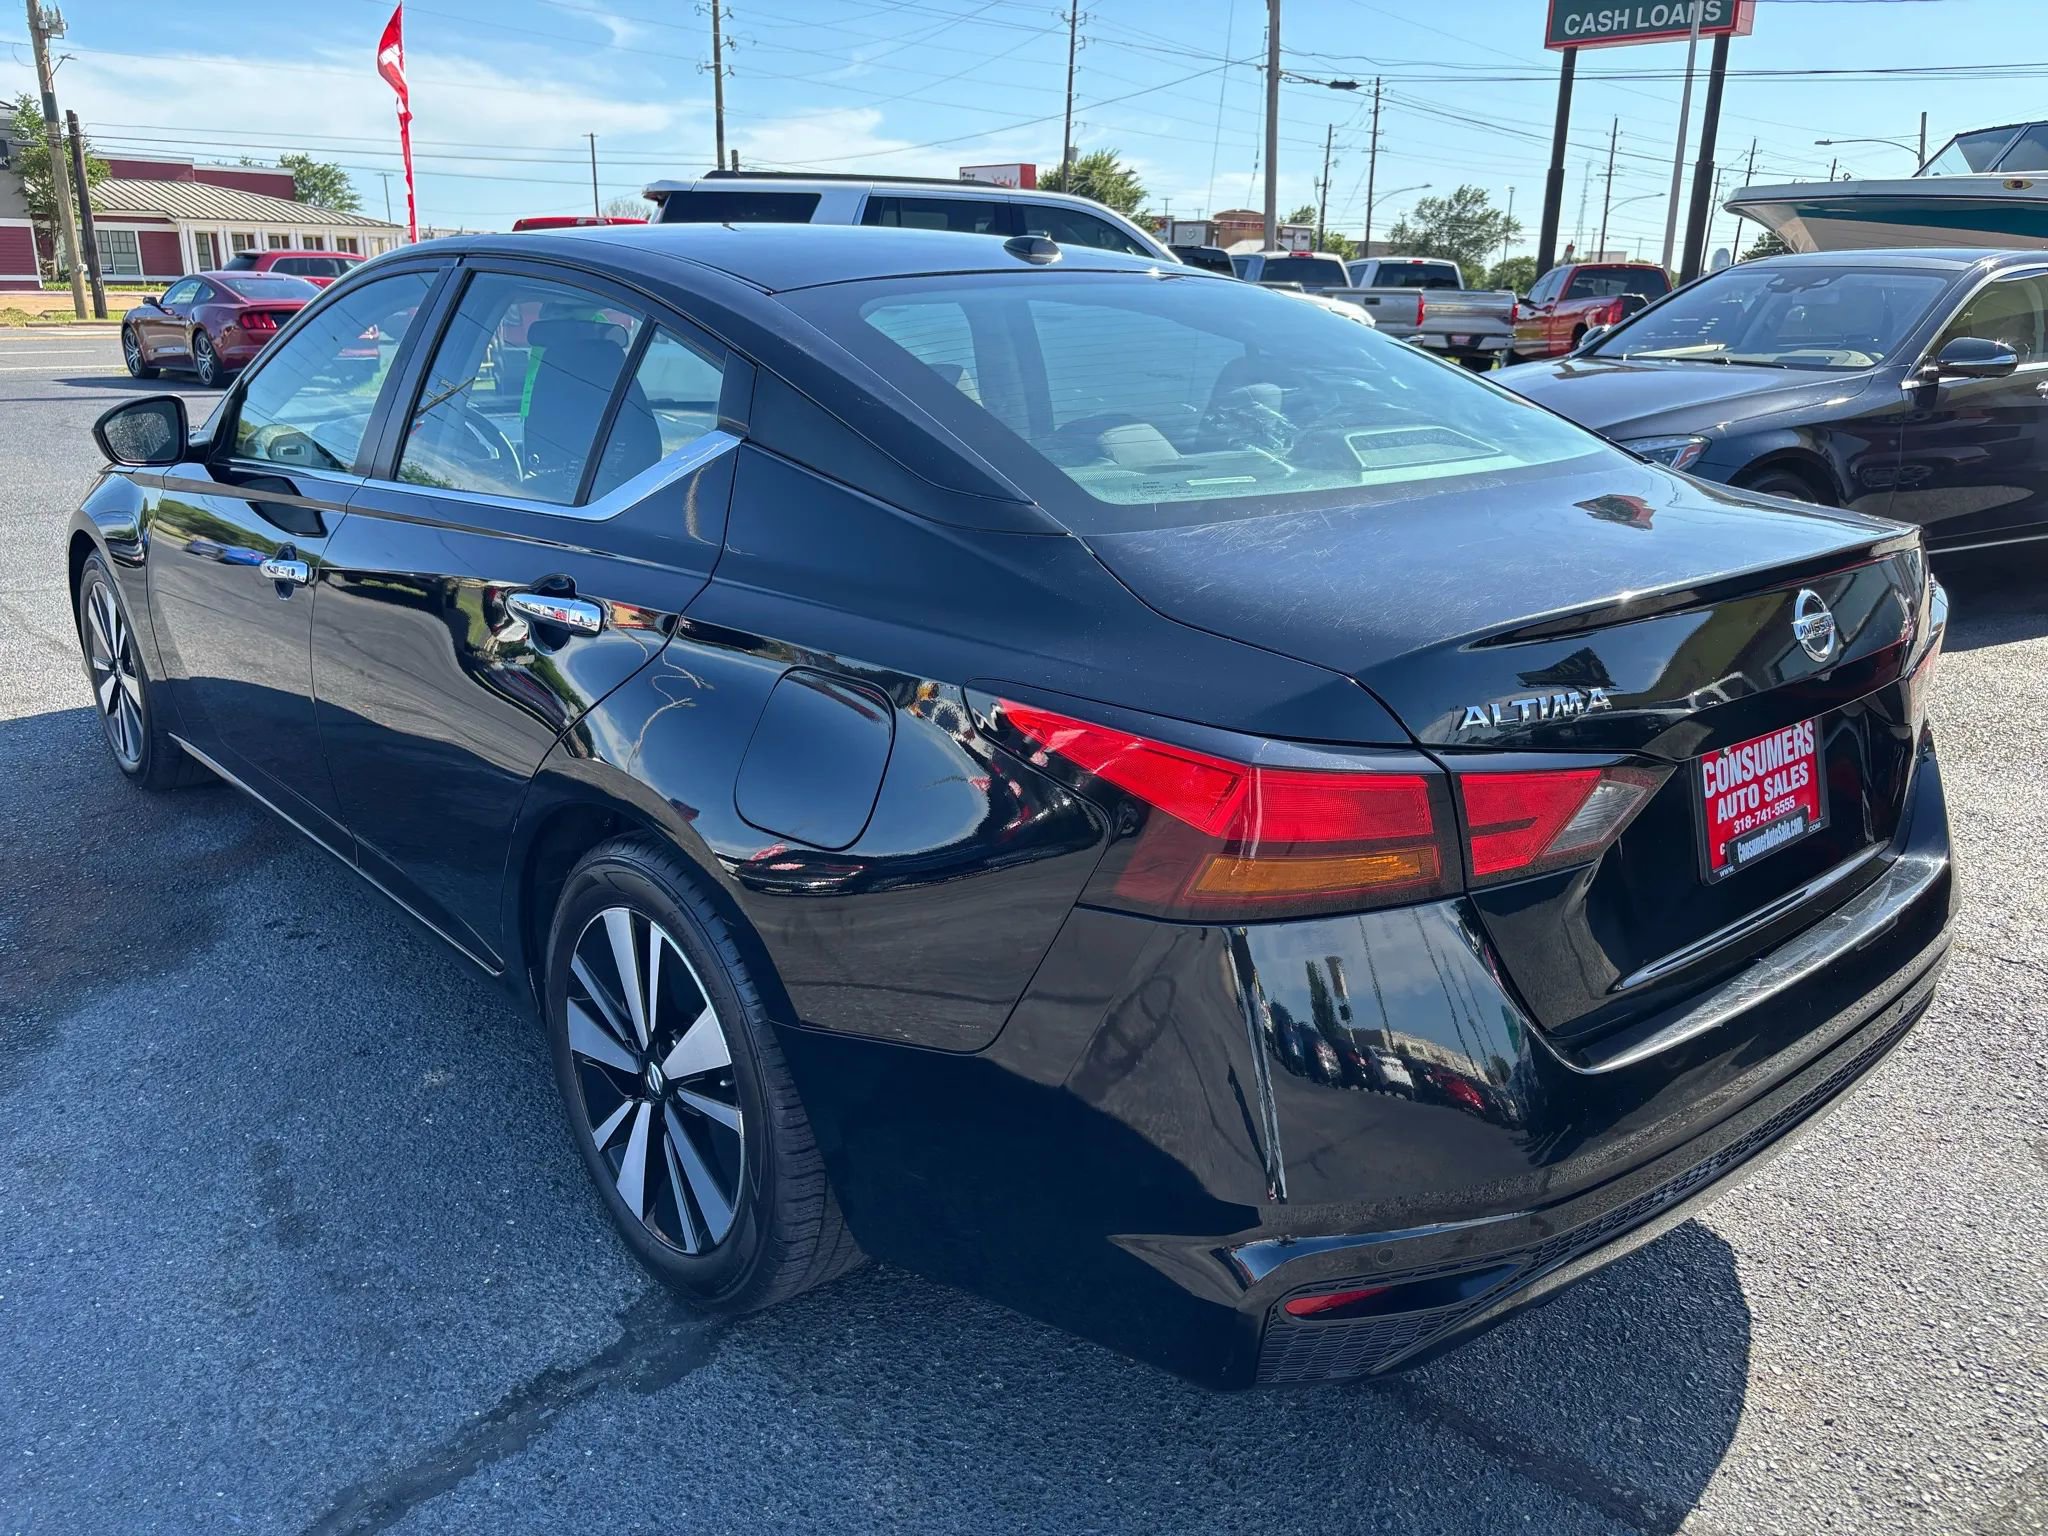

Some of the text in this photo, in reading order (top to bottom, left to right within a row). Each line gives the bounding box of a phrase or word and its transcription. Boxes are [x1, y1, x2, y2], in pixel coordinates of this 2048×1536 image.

[1564, 9, 1630, 35] CASH
[1457, 687, 1613, 731] ALTIMA
[1702, 721, 1815, 799] CONSUMERS
[1717, 761, 1809, 824] AUTO SALES
[1734, 795, 1796, 834] 318-741-5555
